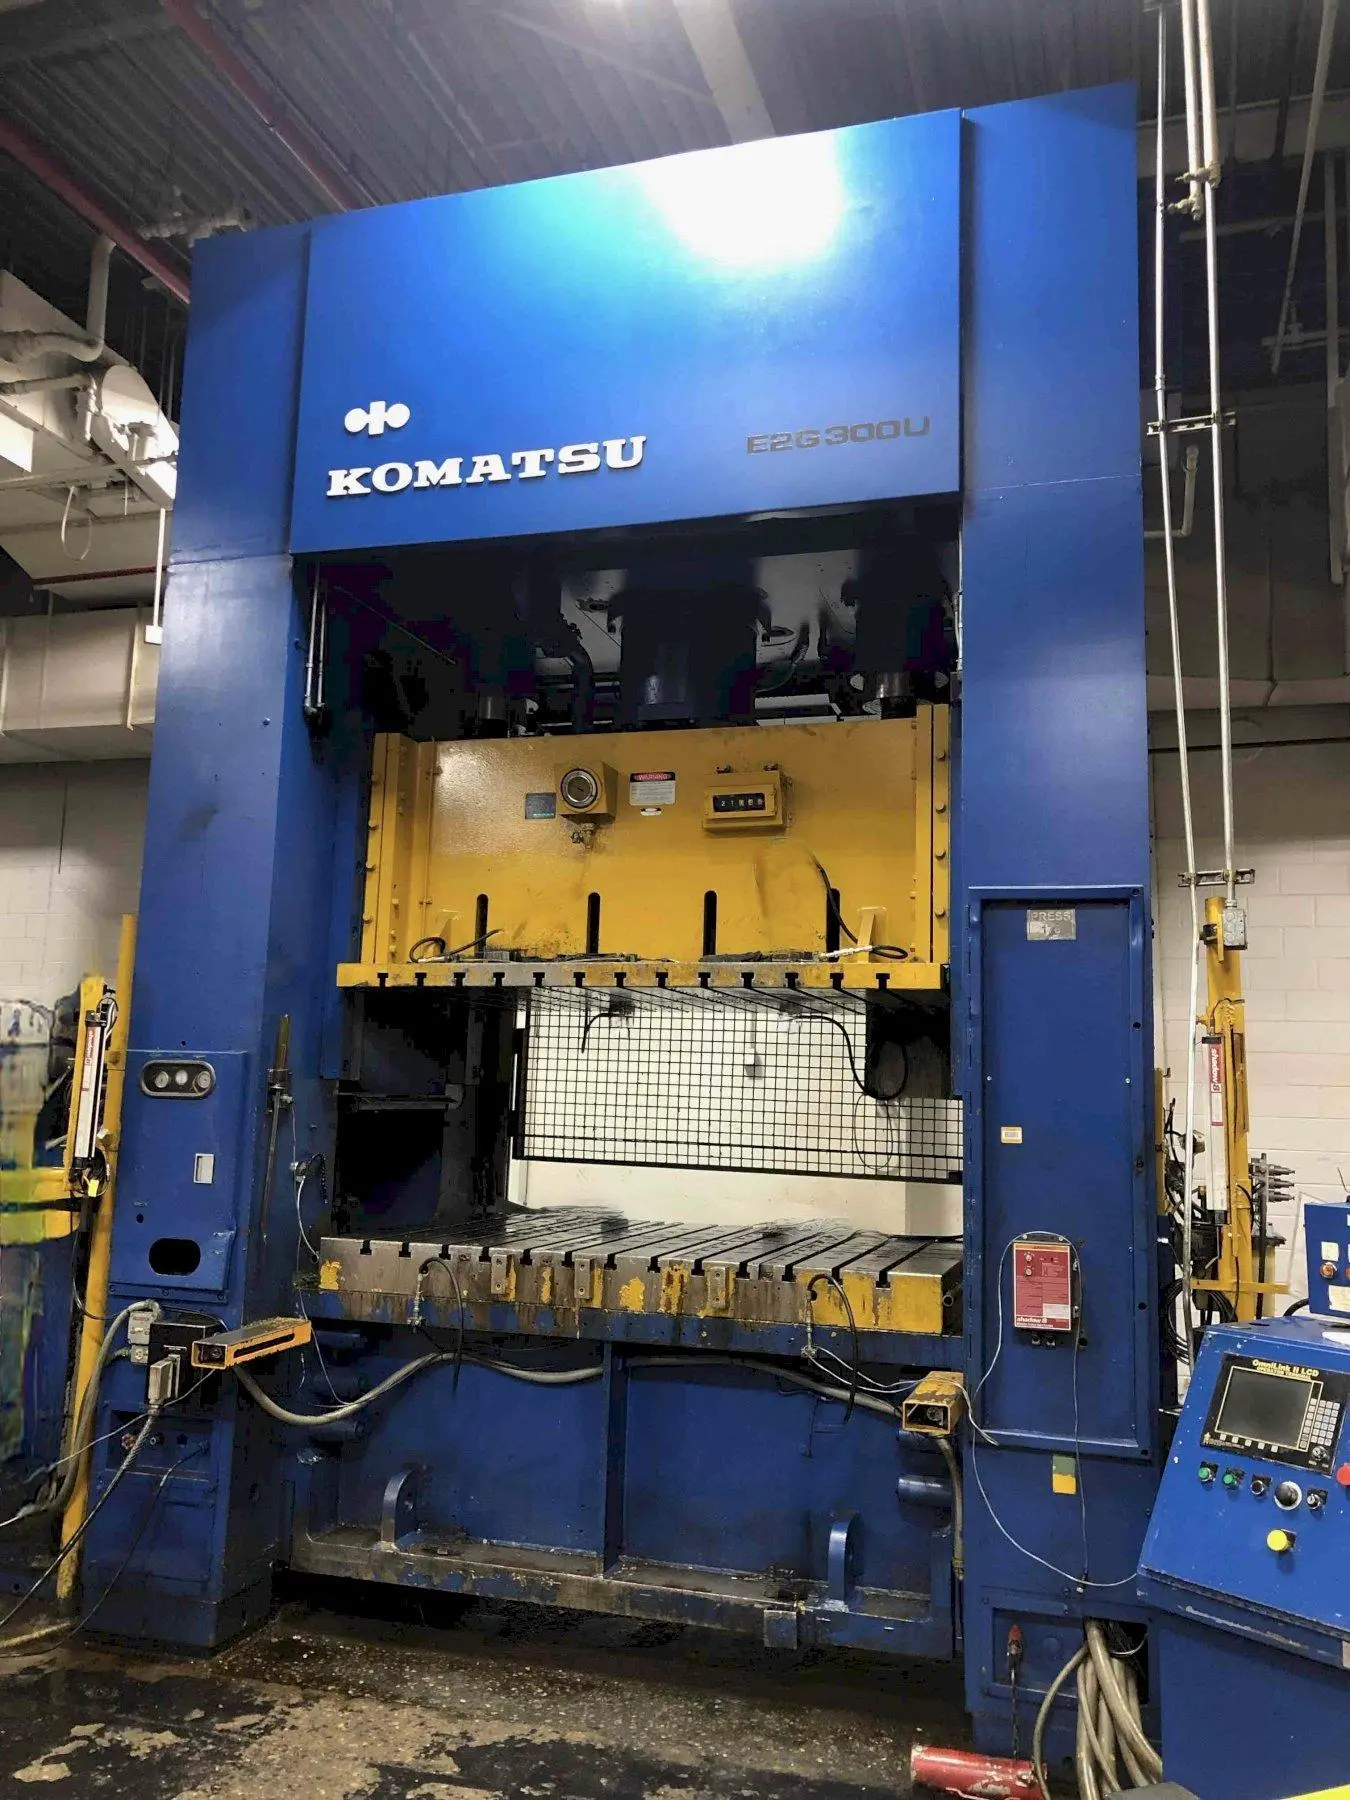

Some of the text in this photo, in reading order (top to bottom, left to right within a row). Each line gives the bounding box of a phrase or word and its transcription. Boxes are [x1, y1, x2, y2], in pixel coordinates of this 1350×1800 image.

[327, 435, 647, 497] KOMATSU
[638, 773, 668, 781] WARNING
[1031, 911, 1072, 921] PRESS
[1211, 1047, 1220, 1083] shadow
[1252, 1359, 1291, 1372] OmniLink
[1301, 1367, 1319, 1378] LCD
